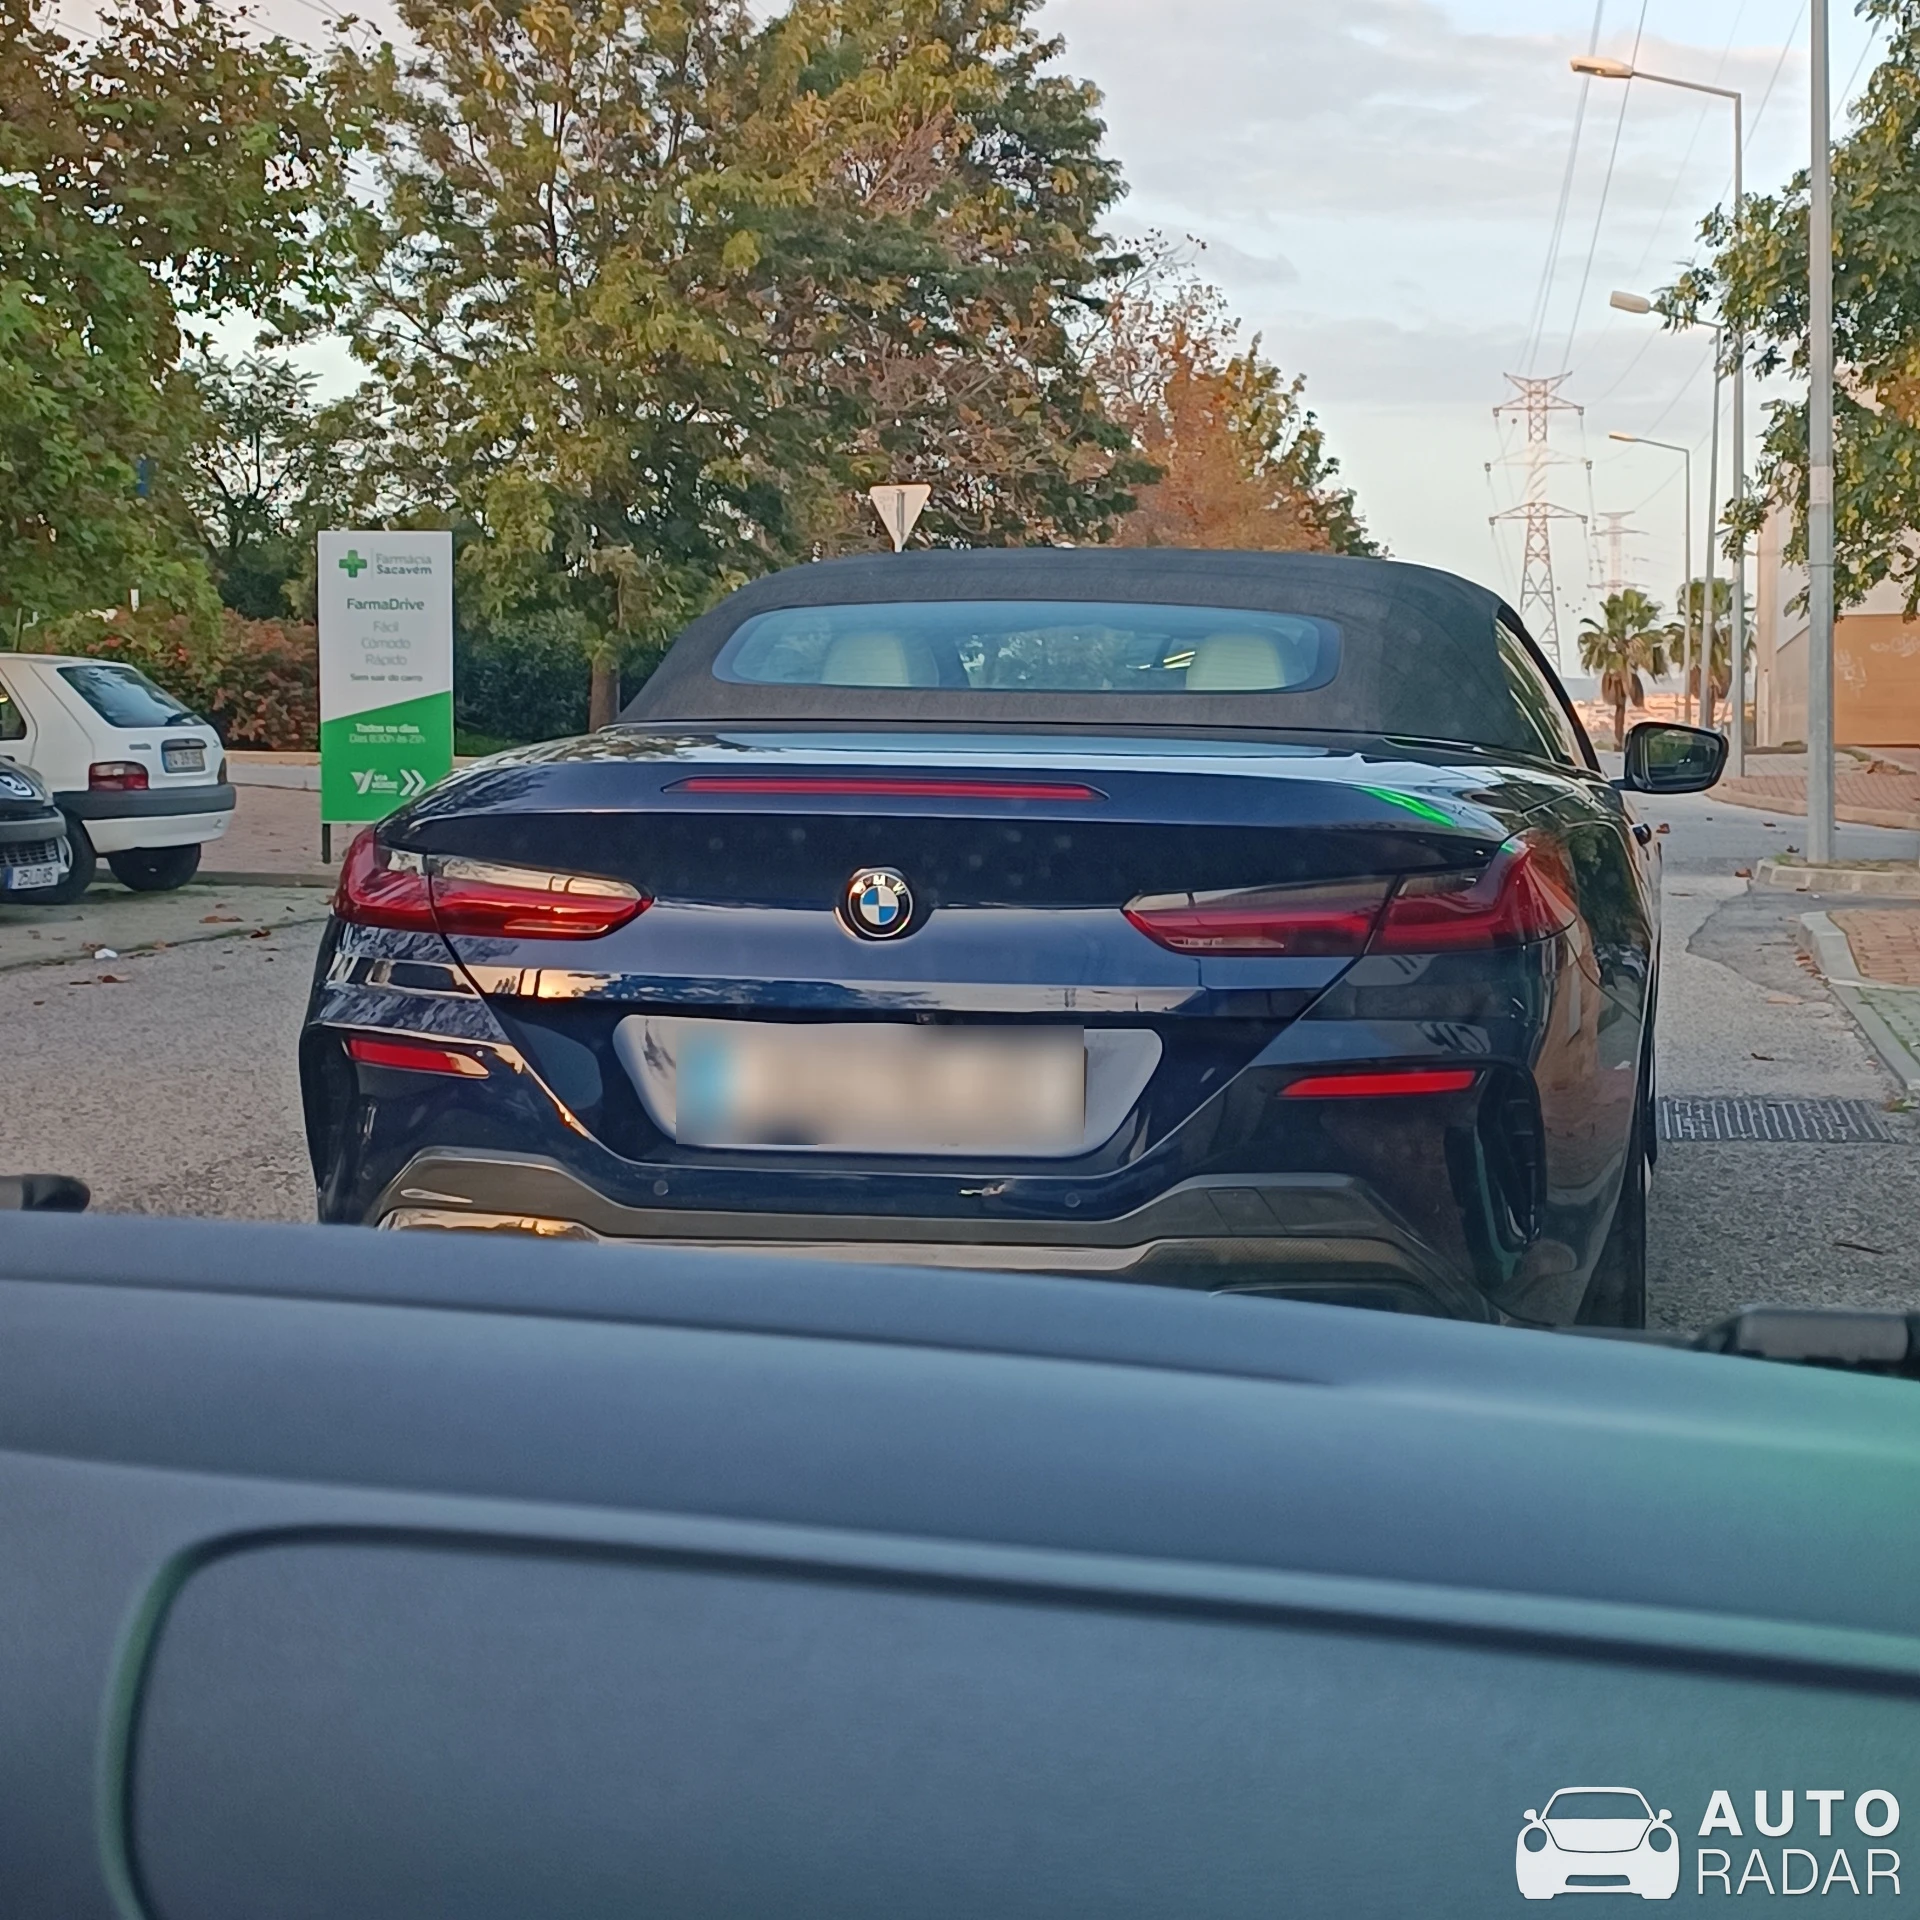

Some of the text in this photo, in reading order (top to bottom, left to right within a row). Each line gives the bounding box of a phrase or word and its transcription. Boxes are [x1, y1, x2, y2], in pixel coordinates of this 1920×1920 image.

[376, 564, 433, 574] Sacavém
[347, 597, 424, 610] FarmaDrive
[852, 874, 907, 895] BMW
